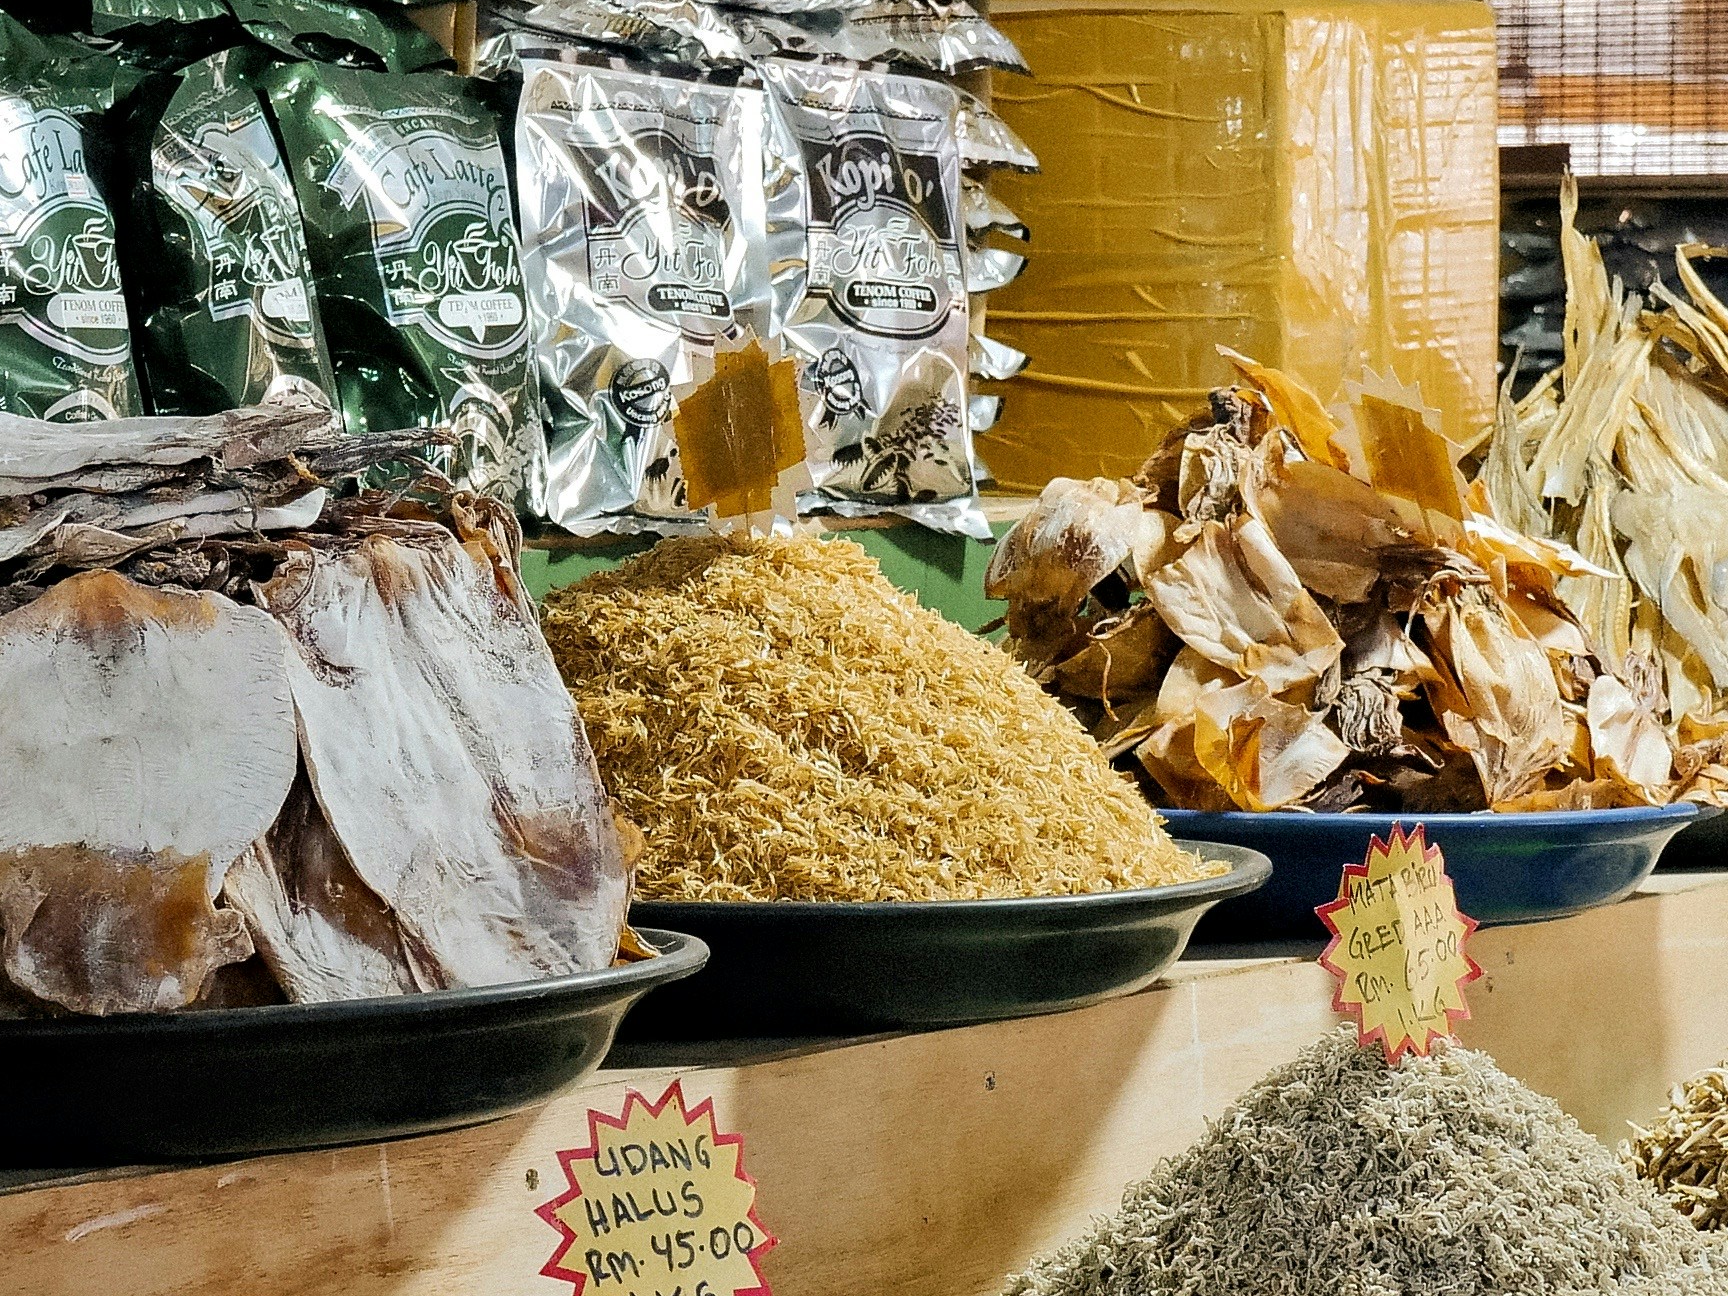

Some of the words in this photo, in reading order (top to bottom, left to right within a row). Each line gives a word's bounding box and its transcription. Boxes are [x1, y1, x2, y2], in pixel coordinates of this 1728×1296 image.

[382, 151, 436, 209] Café
[813, 147, 894, 208] Kopi
[24, 229, 85, 294] Yit
[418, 243, 465, 294] Yit
[477, 239, 524, 293] Foh
[592, 248, 621, 292] 丹南
[620, 227, 682, 283] Yit
[832, 225, 885, 278] Yit
[901, 237, 942, 278] Foh
[60, 297, 95, 314] TENOM
[214, 254, 238, 305] 丹南
[478, 297, 514, 313] COFFEE
[656, 287, 693, 304] TENOM
[693, 289, 731, 307] COFFEE
[853, 283, 895, 299] TENOM
[895, 287, 935, 303] COFFEE
[79, 312, 98, 326] since
[98, 312, 117, 327] 1960
[619, 377, 667, 405] Kosong
[1348, 873, 1398, 915] MATA
[1347, 919, 1405, 960] GRED
[1413, 902, 1447, 939] AAA
[1404, 930, 1457, 992] 65.00
[594, 1134, 711, 1177] UDANG
[584, 1180, 704, 1238] HALUS
[585, 1249, 646, 1287] RM.
[651, 1221, 754, 1273] 45.00
